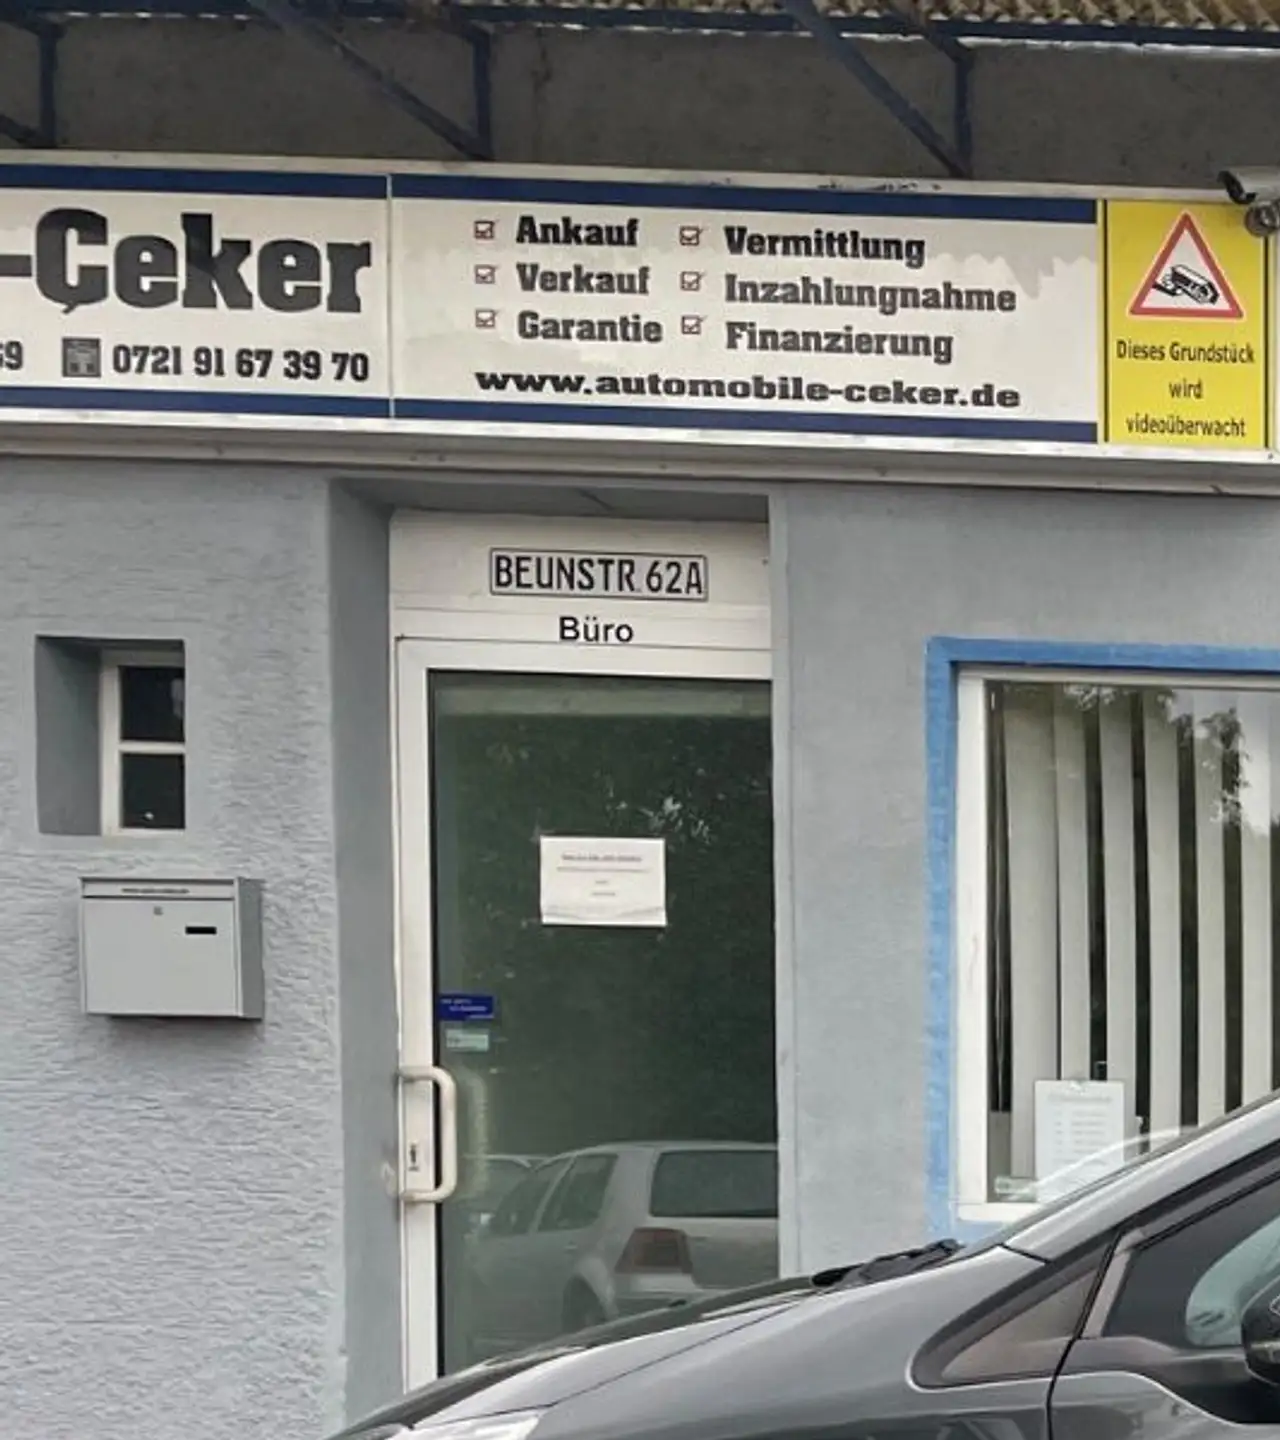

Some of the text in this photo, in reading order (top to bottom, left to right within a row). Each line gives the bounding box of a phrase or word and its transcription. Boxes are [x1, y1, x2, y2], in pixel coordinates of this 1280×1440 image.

[514, 214, 640, 248] Ankauf
[724, 226, 926, 268] Vermittlung
[515, 262, 650, 295] Verkauf
[724, 272, 1017, 316] Inzahlungnahme
[517, 310, 663, 344] Garantie
[725, 319, 954, 366] Finanzierung
[112, 344, 182, 376] 0721
[193, 346, 225, 377] 91
[235, 348, 274, 378] 67
[283, 349, 322, 381] 39
[331, 352, 369, 382] 70
[1116, 339, 1255, 364] Dieses Grundstück
[474, 370, 1021, 409] www.automobile-ceker.de
[1168, 378, 1203, 400] wird
[1125, 412, 1246, 438] videoüberwacht
[645, 560, 703, 595] 62A
[559, 615, 634, 643] Büro
